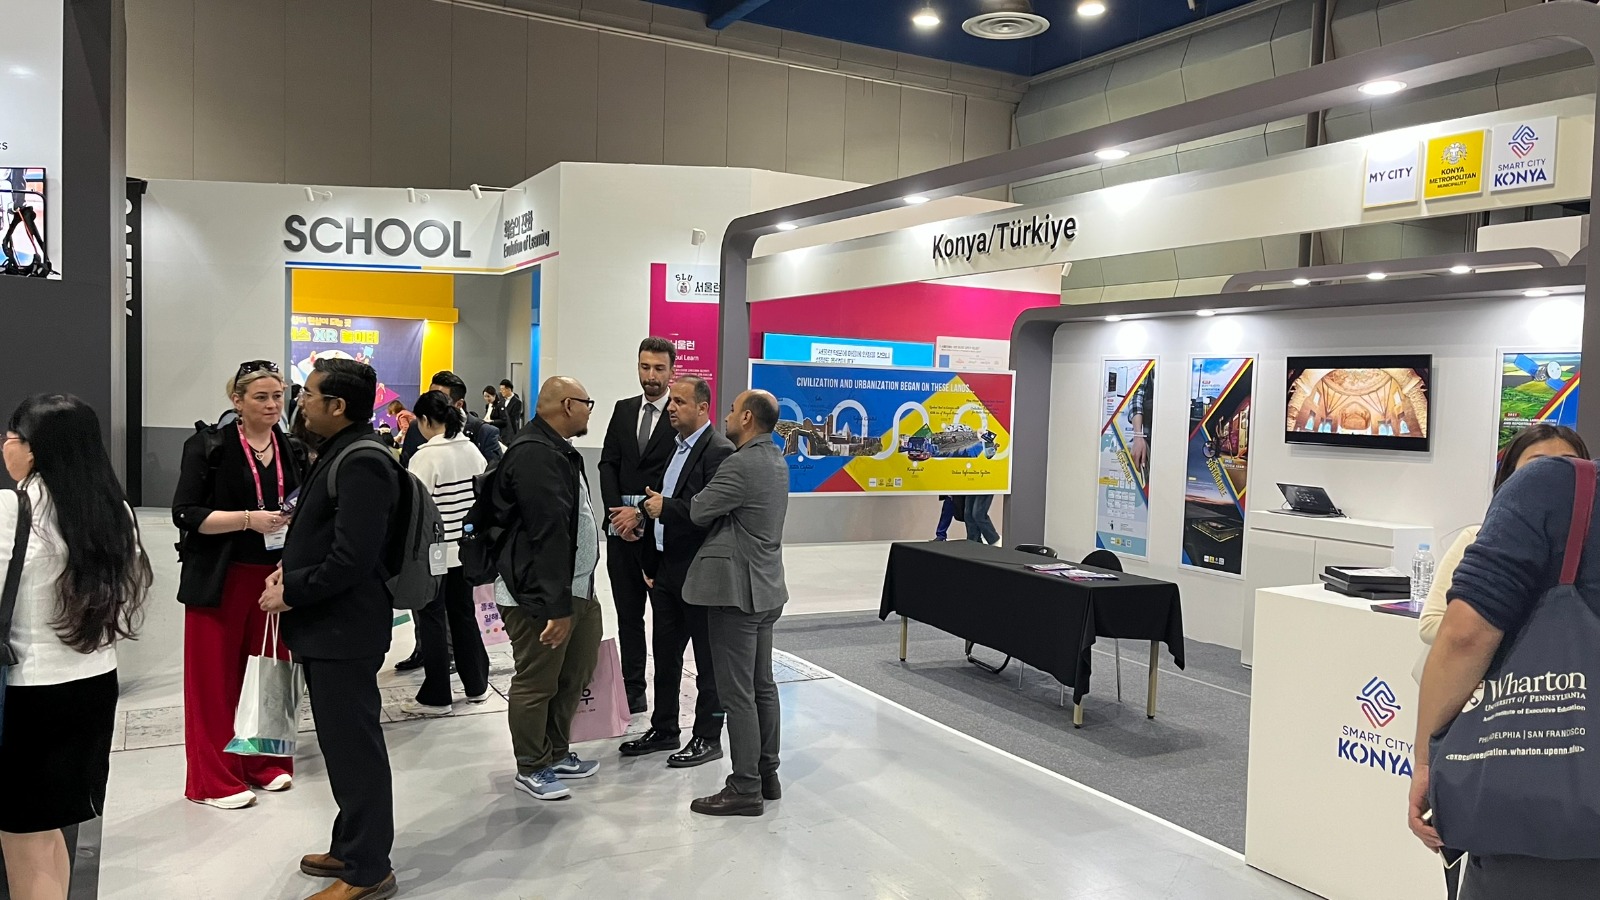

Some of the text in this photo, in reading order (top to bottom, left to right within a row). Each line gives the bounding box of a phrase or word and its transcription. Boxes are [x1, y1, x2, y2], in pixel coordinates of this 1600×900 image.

[1441, 166, 1465, 176] KONYA
[1497, 158, 1547, 172] SMART CITY
[1369, 166, 1413, 183] MY CITY
[1429, 172, 1477, 185] METROPOLITAN
[1494, 167, 1547, 187] KONYA
[1437, 181, 1467, 189] MUNICIPALITY
[521, 209, 534, 235] 진화
[283, 214, 471, 258] SCHOOL
[503, 229, 550, 258] Evolution of Learning
[932, 213, 1077, 262] Konya/Türkiye
[675, 273, 693, 281] SLU
[312, 327, 338, 343] XR
[340, 329, 379, 345] 놀이터
[796, 377, 839, 388] CIVILIZATION
[839, 379, 853, 389] AND
[854, 379, 899, 391] URBANIZATION
[900, 381, 920, 391] BEGAN
[921, 382, 930, 391] ON
[930, 382, 950, 392] THESE
[1488, 671, 1587, 701] Wharton
[1517, 694, 1527, 704] of
[1525, 707, 1556, 715] Executive
[1557, 703, 1586, 713] Education
[1342, 725, 1413, 753] SMART CITY
[1478, 731, 1521, 744] PHILADELPHIA
[1527, 730, 1544, 739] SAN
[1338, 737, 1413, 778] KONYA
